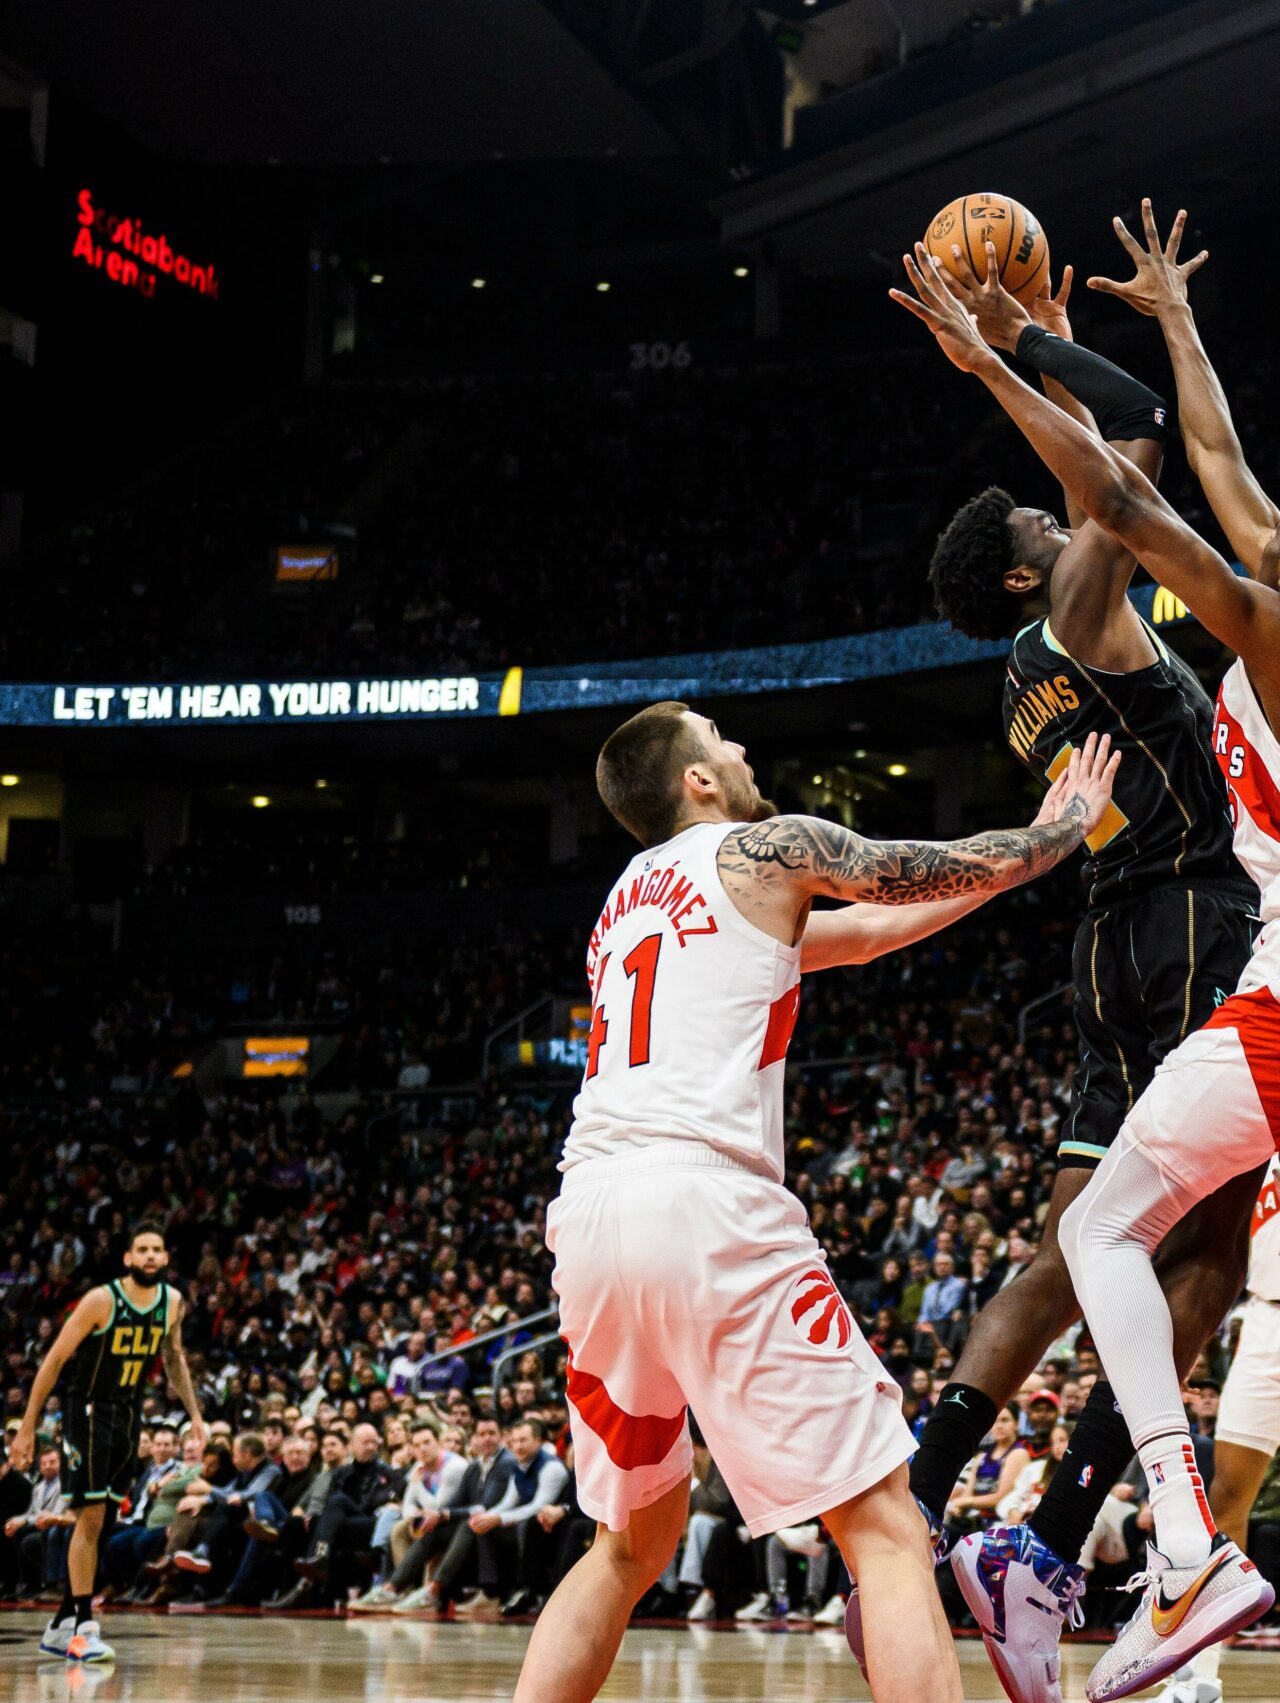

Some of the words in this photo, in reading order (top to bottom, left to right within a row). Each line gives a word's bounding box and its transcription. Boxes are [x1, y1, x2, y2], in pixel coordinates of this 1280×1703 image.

[628, 341, 692, 370] 306
[53, 686, 115, 721] LET
[121, 686, 173, 720] 'EM
[179, 683, 261, 719] HEAR
[268, 681, 351, 717] YOUR
[357, 677, 480, 714] HUNGER
[1009, 675, 1080, 762] WILLIAMS
[586, 932, 663, 1083] 41
[111, 1326, 164, 1356] CLT
[119, 1361, 143, 1387] 11
